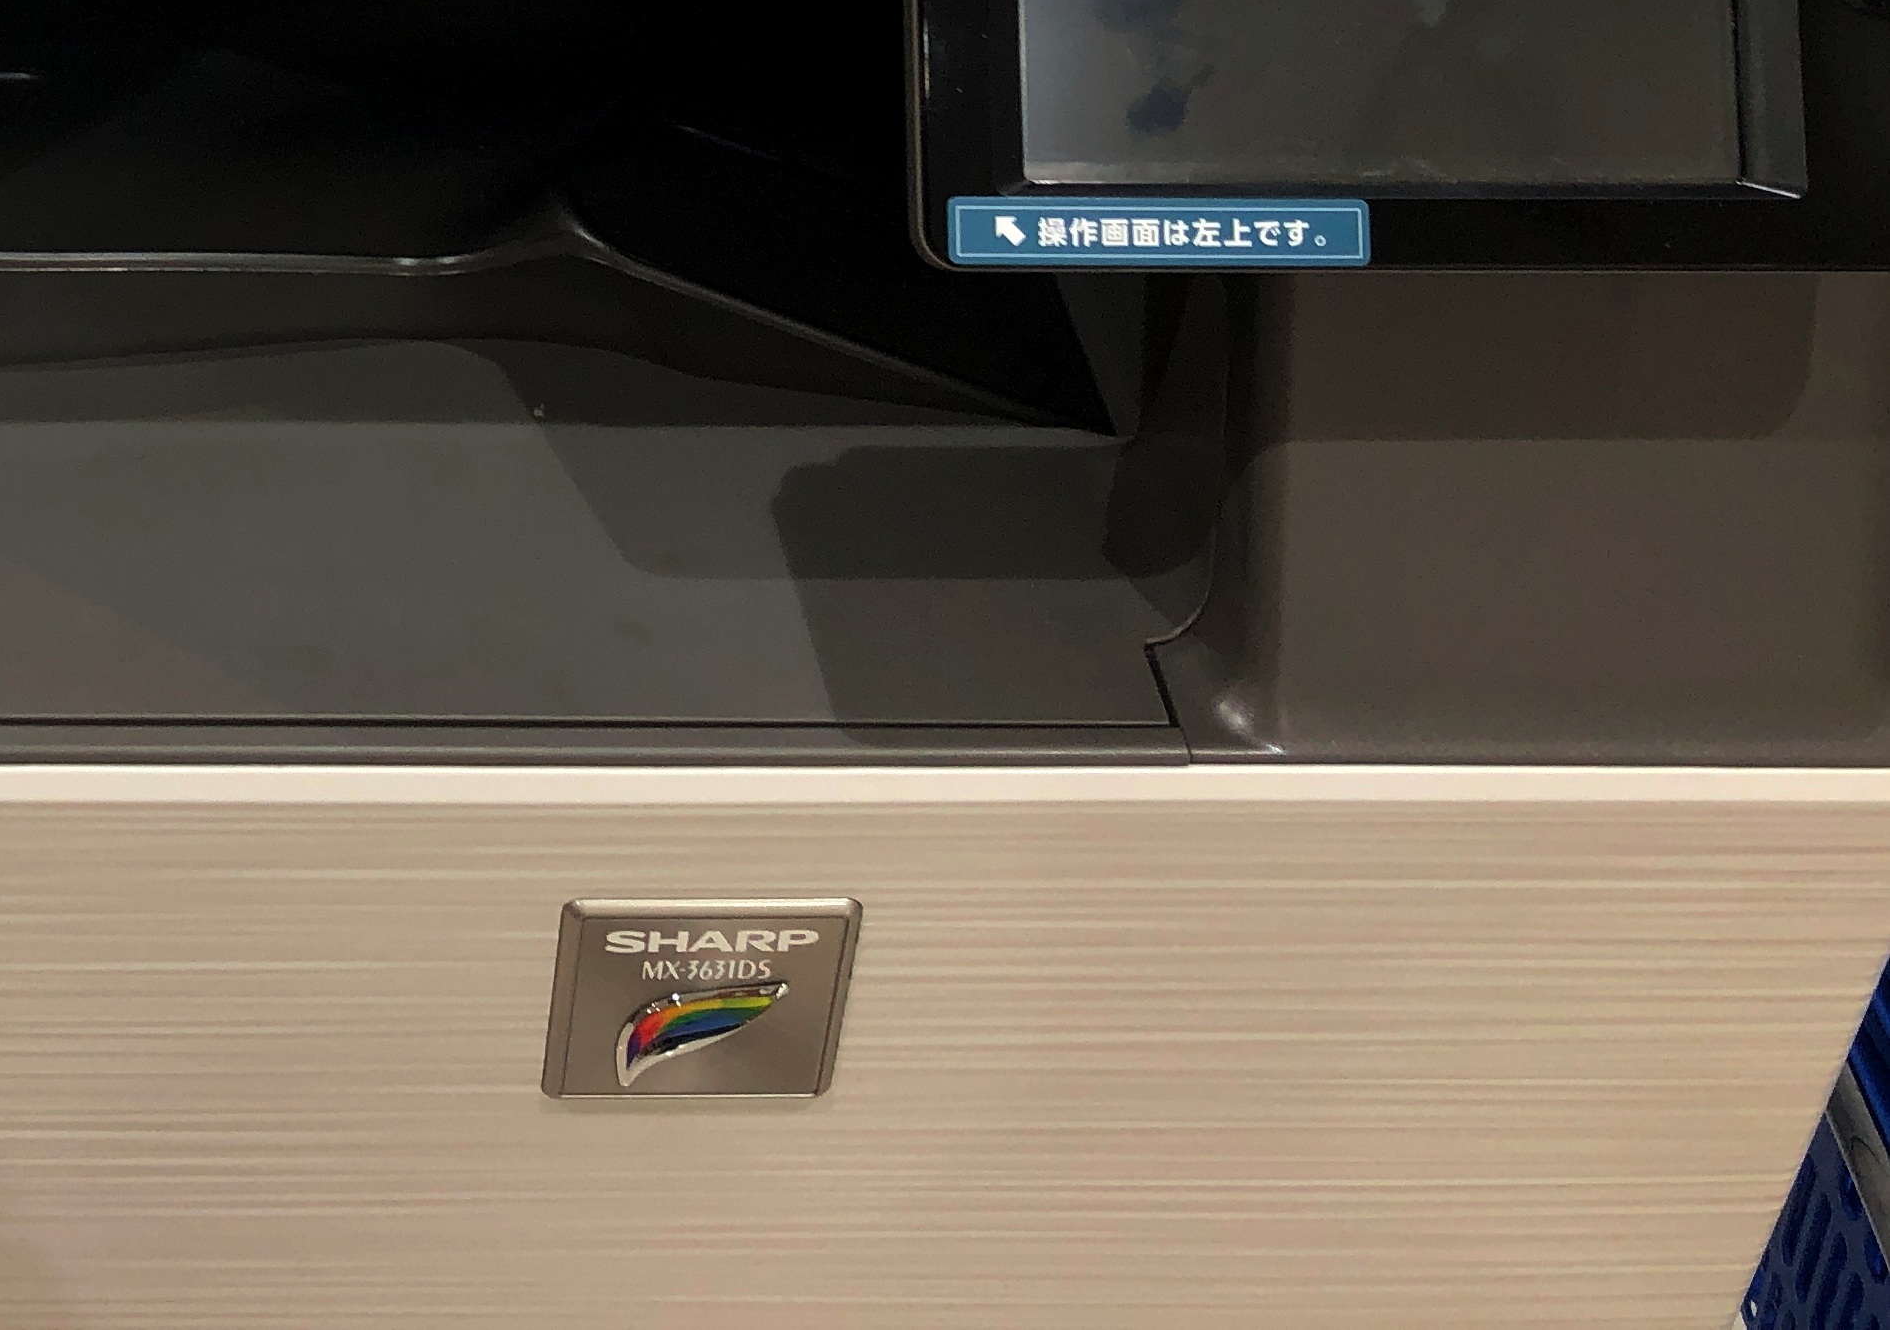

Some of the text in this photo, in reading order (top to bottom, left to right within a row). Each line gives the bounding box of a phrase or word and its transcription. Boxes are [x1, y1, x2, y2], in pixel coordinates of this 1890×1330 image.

[1037, 217, 1327, 250] 操作画面は左上です。
[604, 929, 820, 955] SHARP
[641, 958, 772, 982] MX-3631DS
